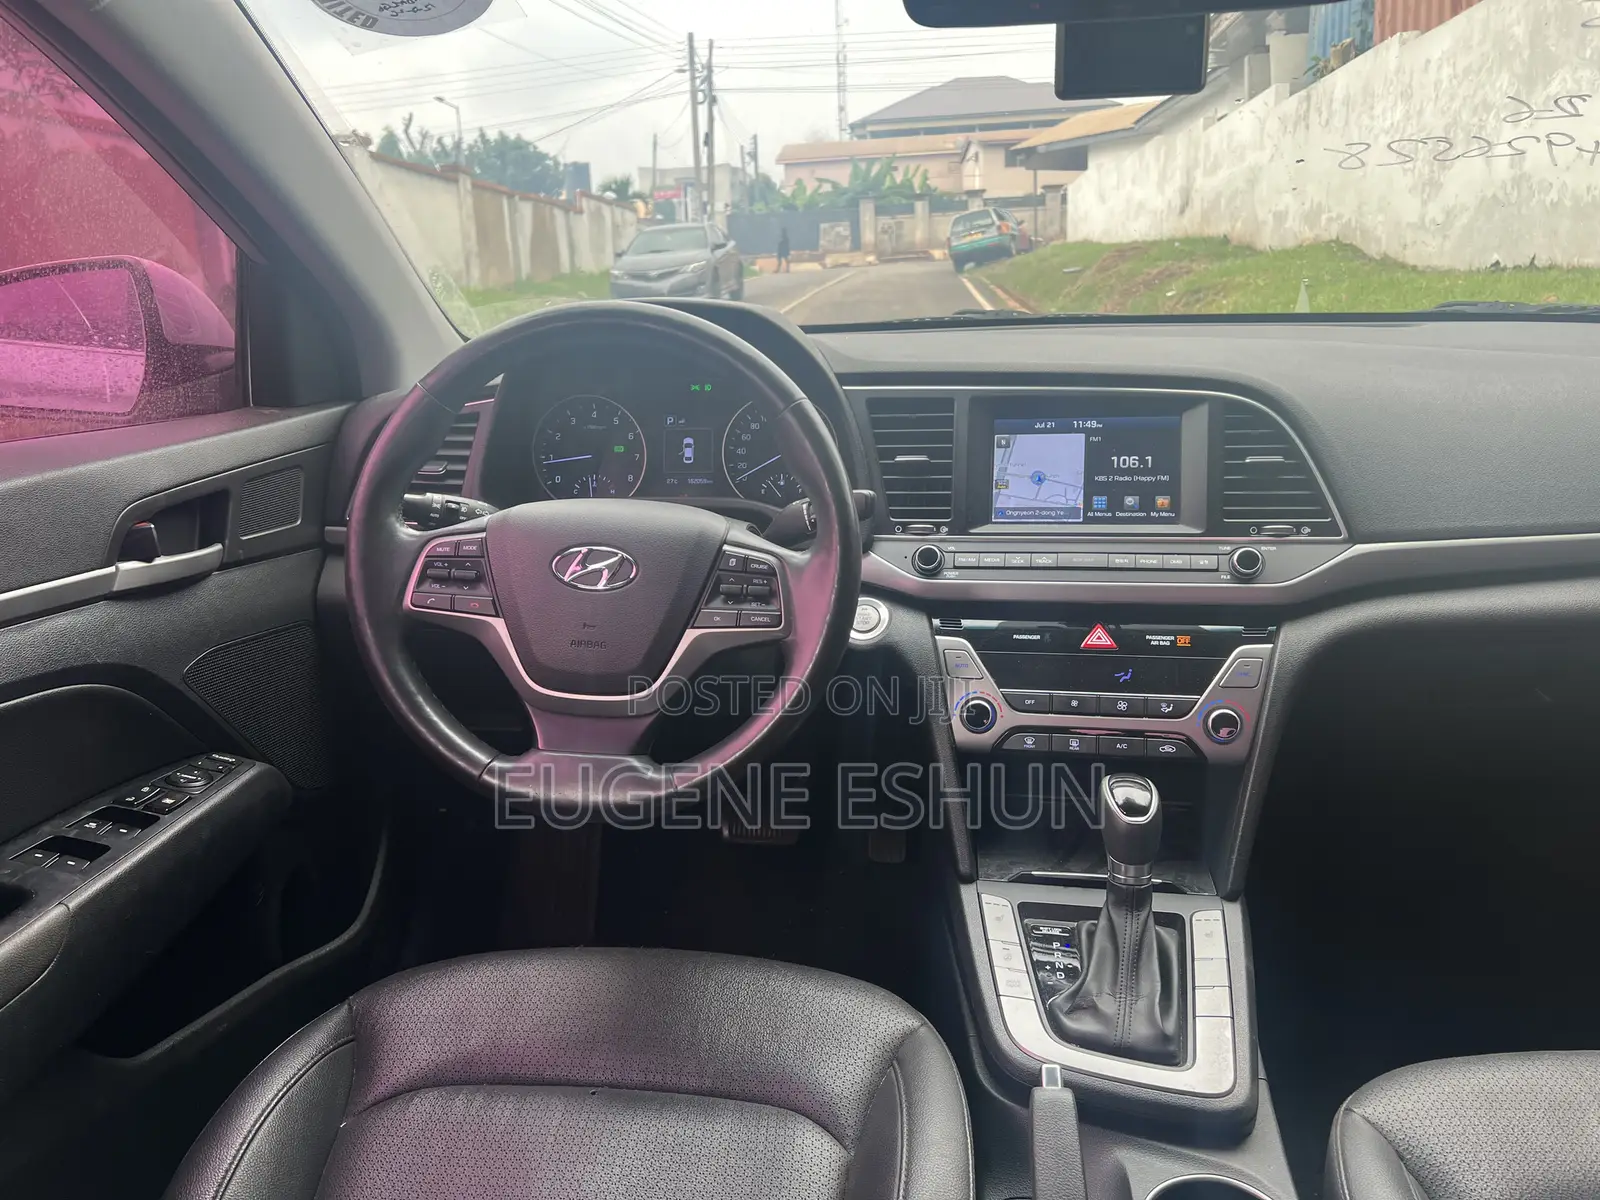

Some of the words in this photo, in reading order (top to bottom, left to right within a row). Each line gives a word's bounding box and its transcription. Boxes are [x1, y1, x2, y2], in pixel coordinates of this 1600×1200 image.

[570, 417, 576, 425] 3
[613, 417, 619, 425] 5
[666, 416, 674, 425] P
[750, 422, 760, 430] 80
[1034, 421, 1045, 429] Jul
[1046, 421, 1055, 429] 21
[628, 432, 634, 440] 6
[741, 433, 751, 441] 60
[736, 447, 746, 455] 40
[1111, 455, 1152, 469] 106.1
[555, 475, 561, 483] 0
[627, 474, 634, 482] 8
[569, 639, 607, 650] AIRBAG
[1176, 637, 1191, 645] OFF
[1055, 961, 1064, 969] N
[1056, 971, 1065, 979] D
